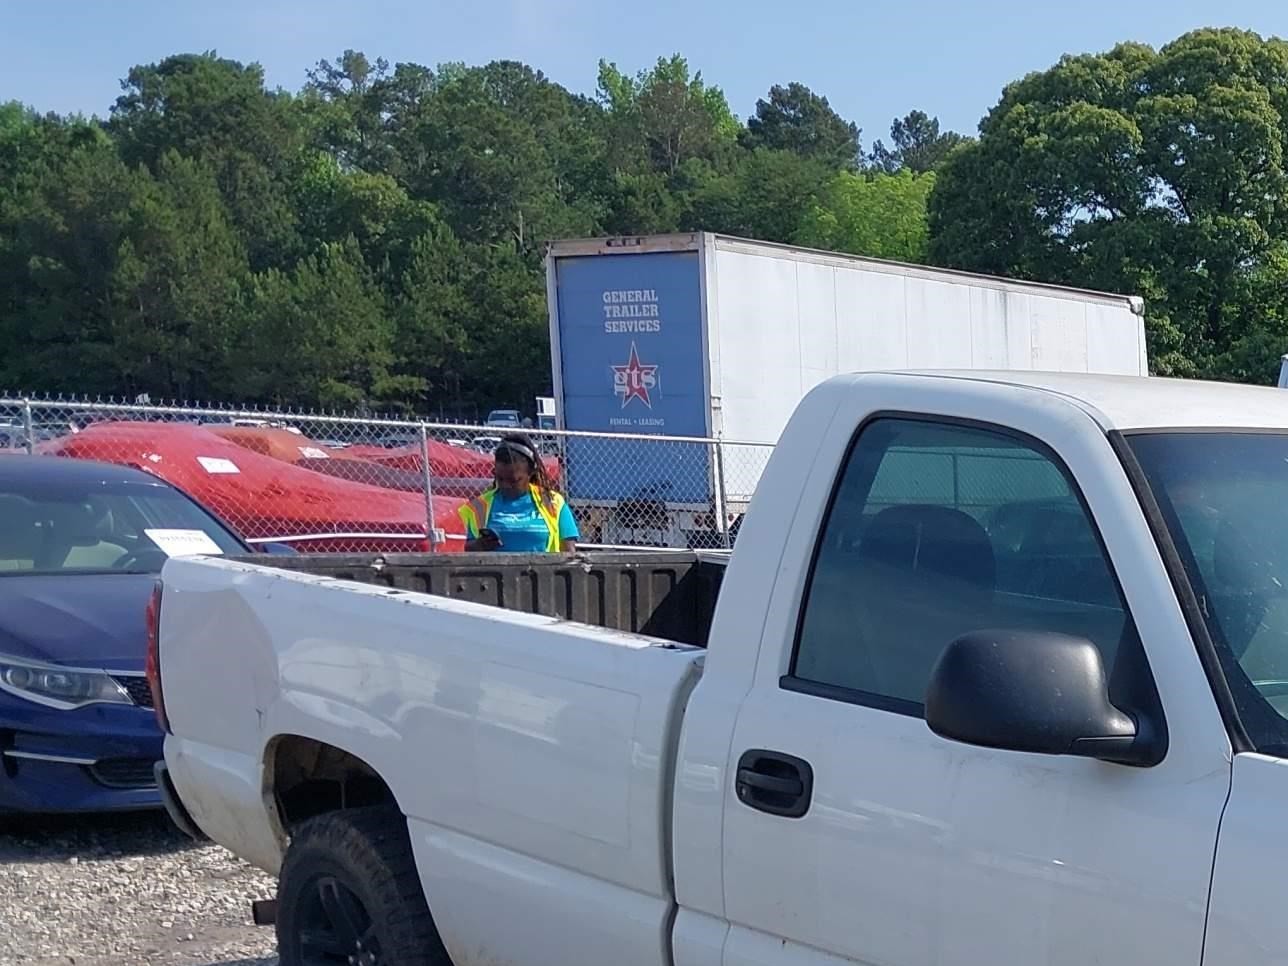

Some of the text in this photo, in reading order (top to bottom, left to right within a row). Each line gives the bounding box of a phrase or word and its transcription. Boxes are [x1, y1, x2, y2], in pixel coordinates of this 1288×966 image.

[602, 289, 658, 303] GENERAL
[603, 304, 659, 317] TRAILER
[605, 320, 660, 333] SERVICES
